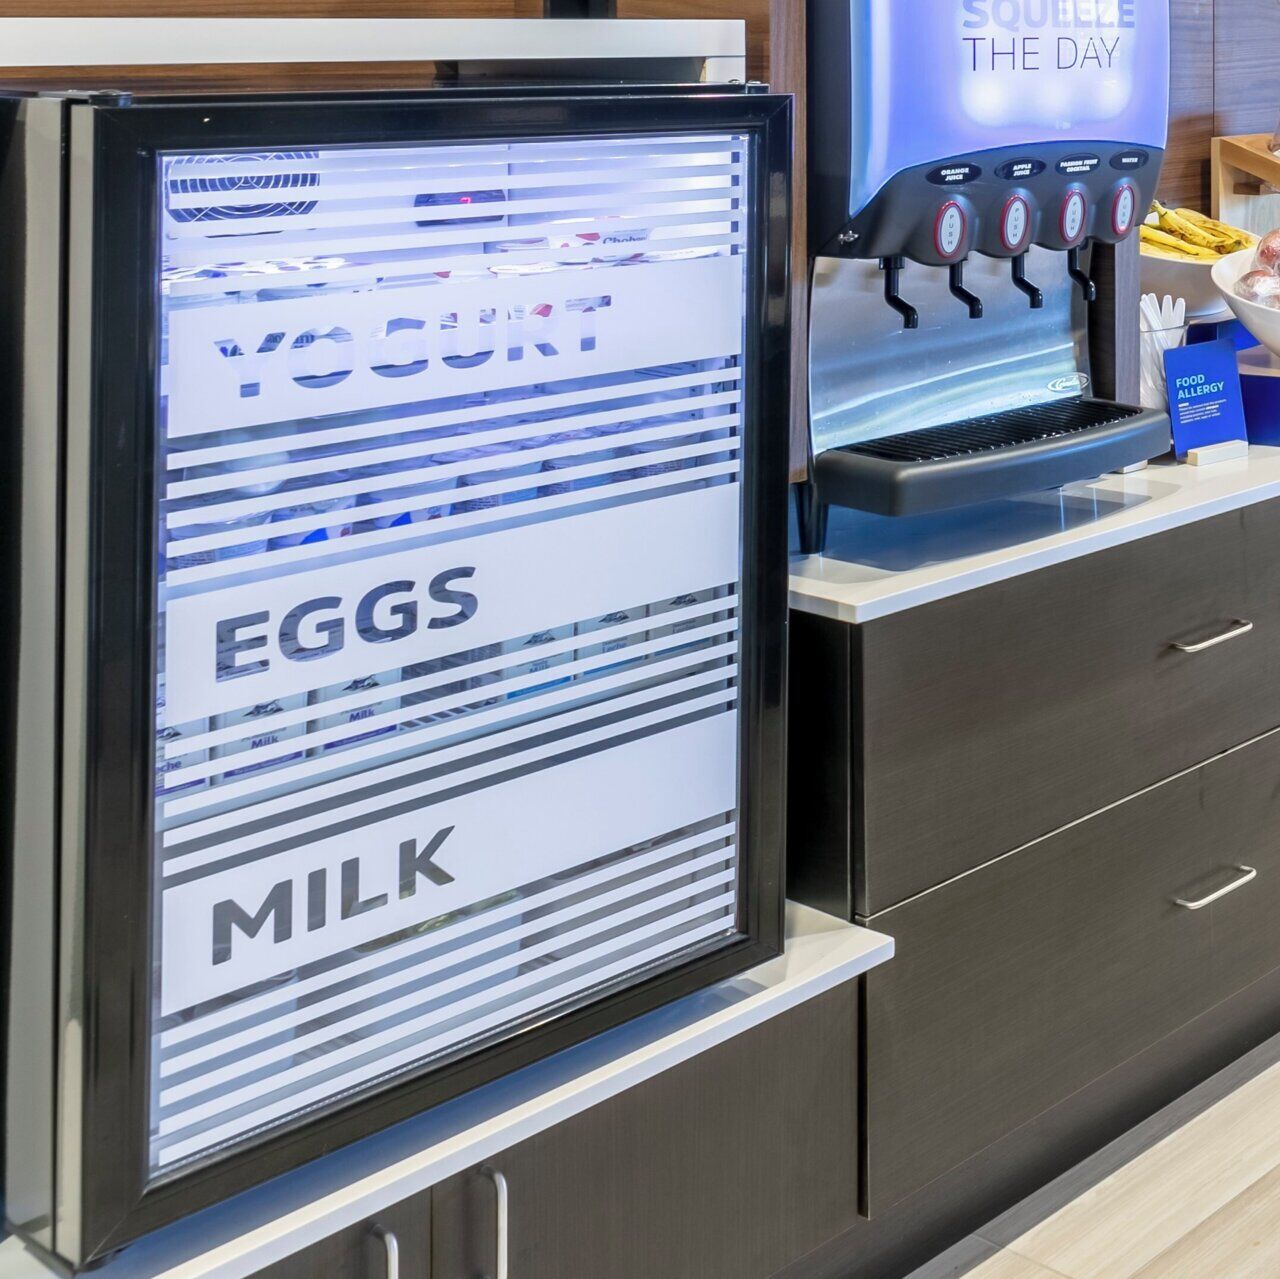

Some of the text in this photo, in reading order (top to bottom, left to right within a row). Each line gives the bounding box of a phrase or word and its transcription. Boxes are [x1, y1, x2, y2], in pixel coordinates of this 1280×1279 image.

[962, 36, 1120, 71] THE DAY
[940, 167, 970, 176] ORANGE
[1013, 163, 1032, 171] APPLE
[1013, 169, 1030, 177] JUICE
[945, 174, 963, 182] JUICE
[213, 295, 612, 399] YOGURT
[1176, 374, 1205, 388] FOOD
[1178, 381, 1224, 400] ALLERGY
[215, 566, 479, 682] EGGS
[251, 735, 279, 749] Milk
[212, 824, 456, 967] MILK
